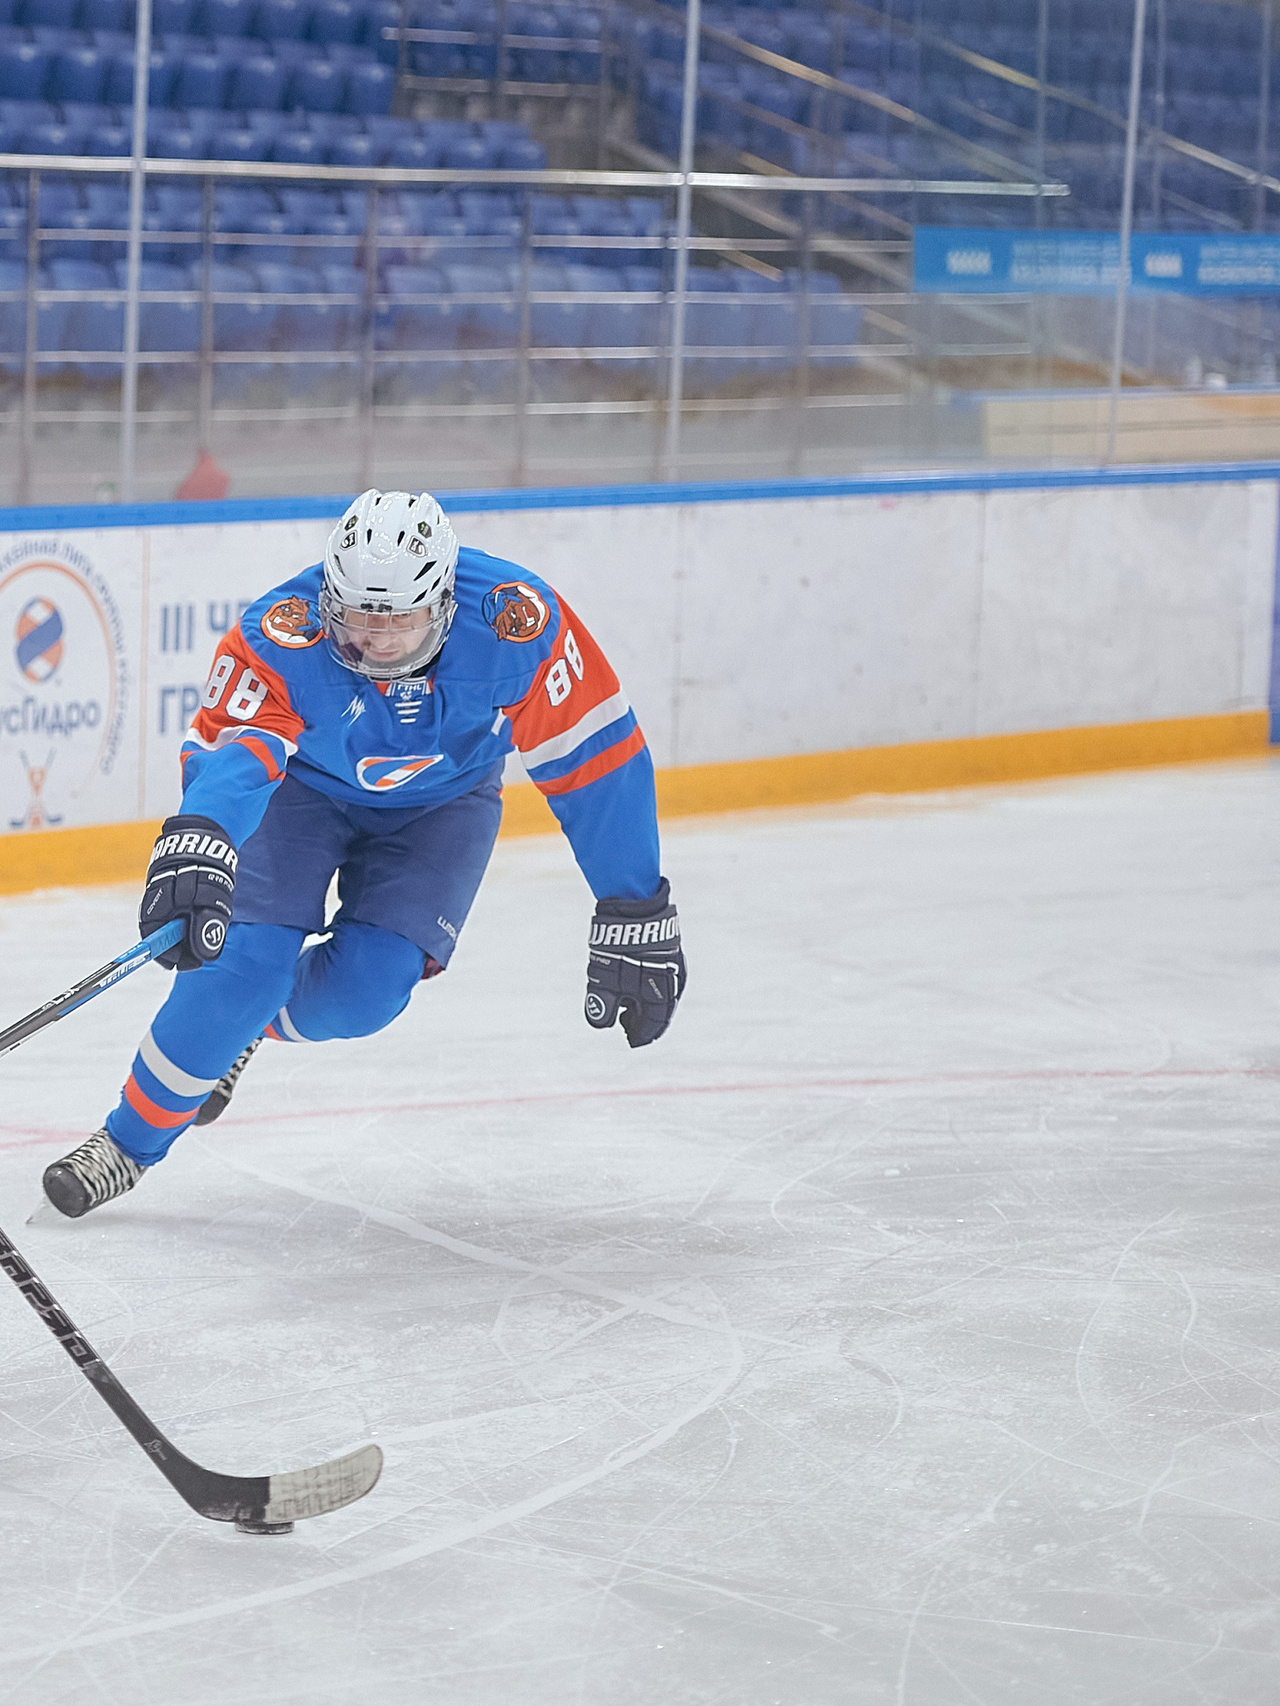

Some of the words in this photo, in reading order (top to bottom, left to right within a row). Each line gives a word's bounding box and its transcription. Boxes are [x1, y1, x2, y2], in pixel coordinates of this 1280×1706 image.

[202, 654, 269, 722] 88
[545, 629, 584, 707] 88
[150, 833, 239, 874] ARRIOR
[589, 916, 680, 946] WARRIO
